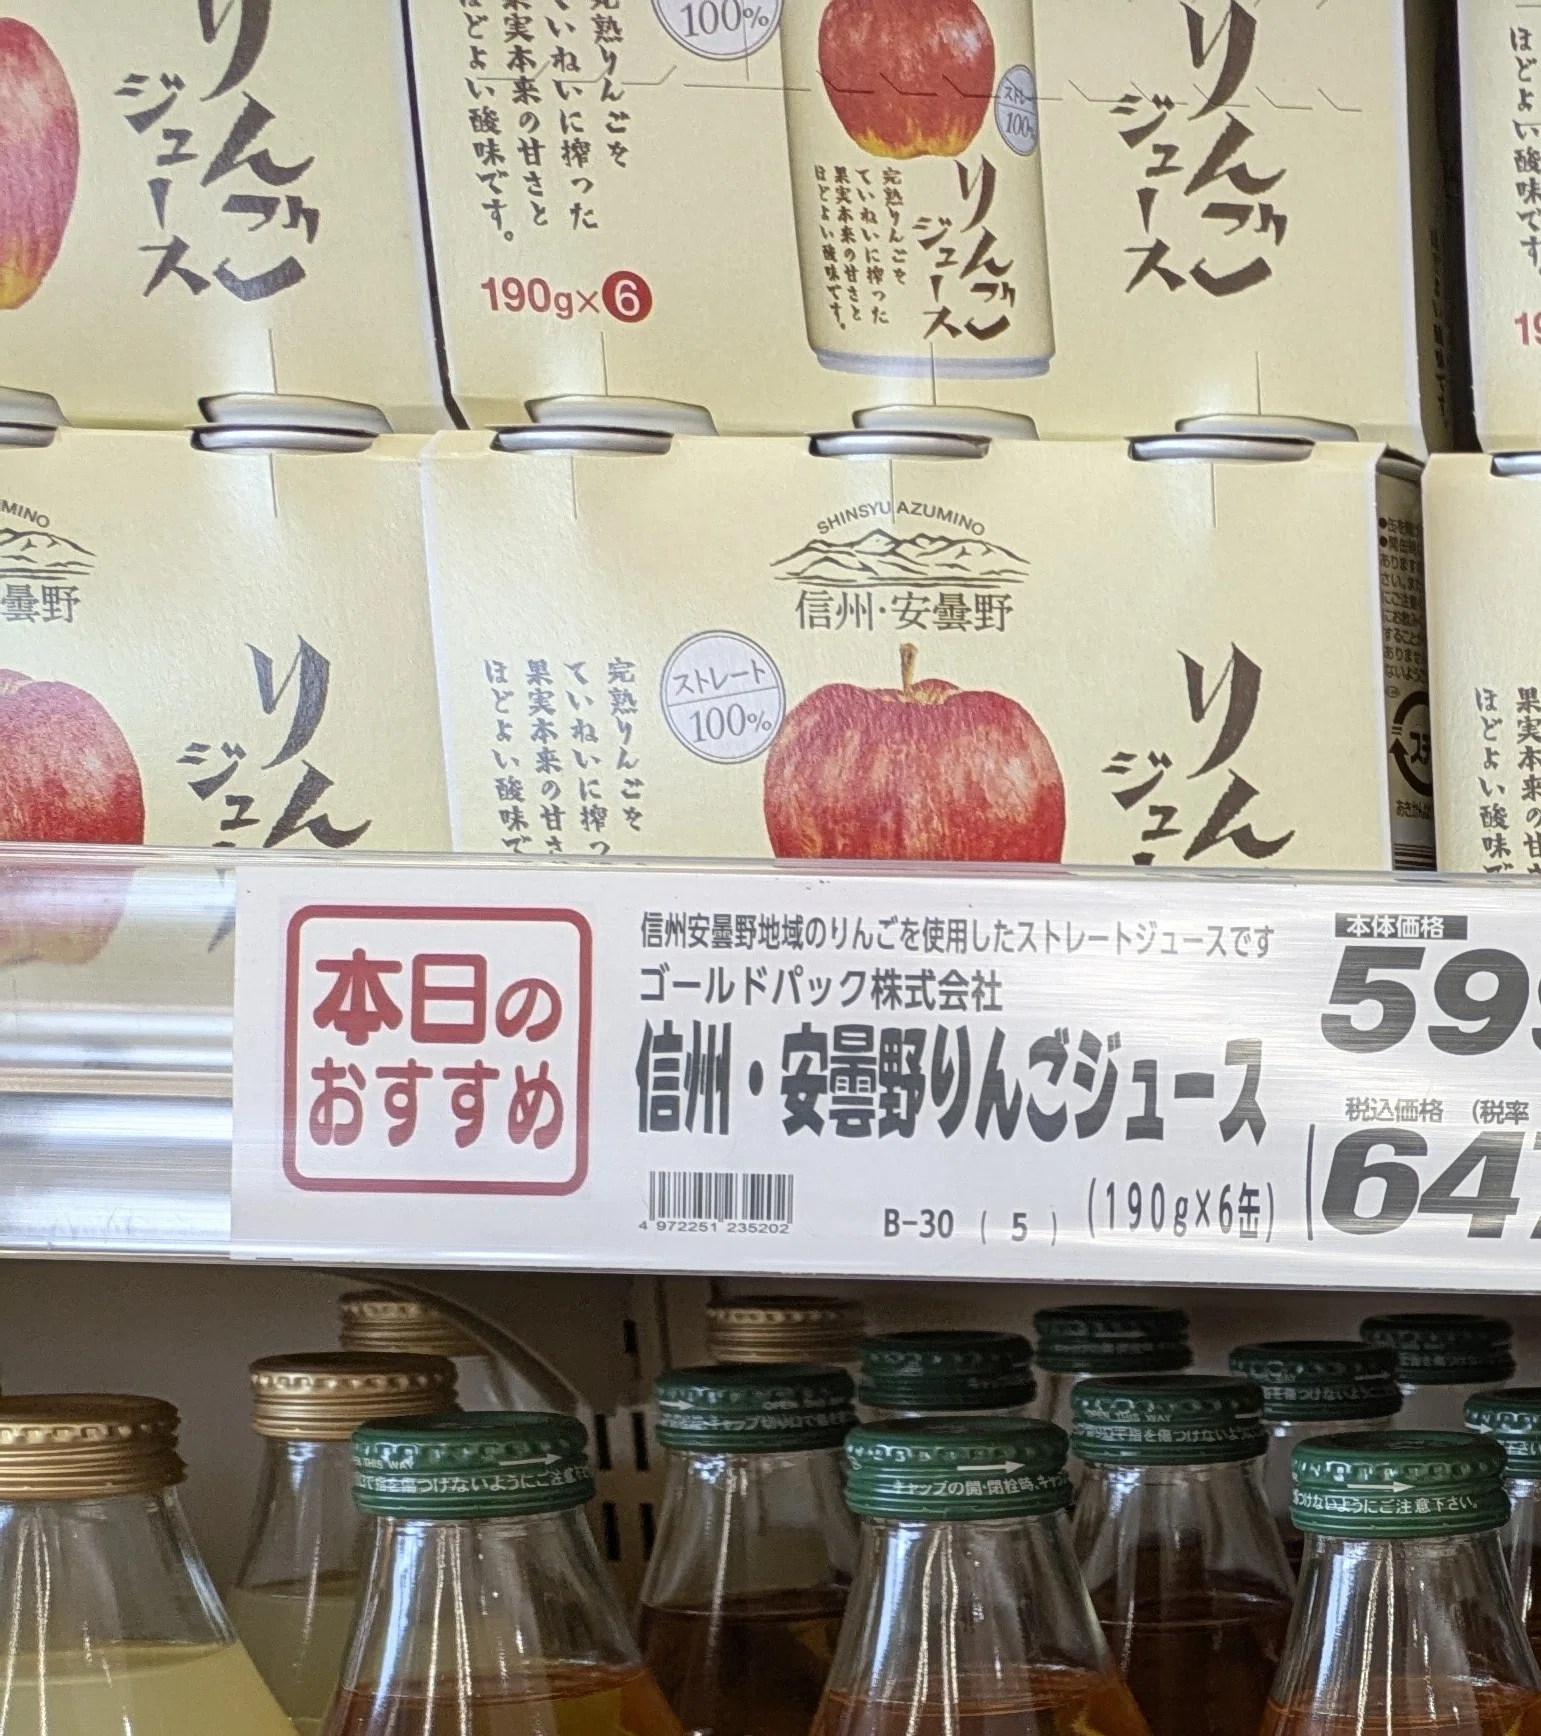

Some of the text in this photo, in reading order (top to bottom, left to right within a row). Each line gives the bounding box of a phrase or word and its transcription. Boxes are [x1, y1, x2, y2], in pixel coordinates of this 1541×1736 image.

[682, 1, 769, 38] 100%
[115, 70, 211, 297] ジュース
[816, 500, 986, 537] SHINSYU AZUMINO
[1345, 913, 1445, 940] 本体価格
[312, 948, 562, 1045] 本日の
[639, 964, 1004, 1014] ゴールドパック株式会社
[635, 1018, 1268, 1148] 信州・安曇野りんごジュース
[309, 1056, 566, 1150] おすすめ
[1345, 1098, 1444, 1124] 税込価格
[656, 1221, 789, 1234] 972251 235202
[883, 1209, 954, 1241] B-30
